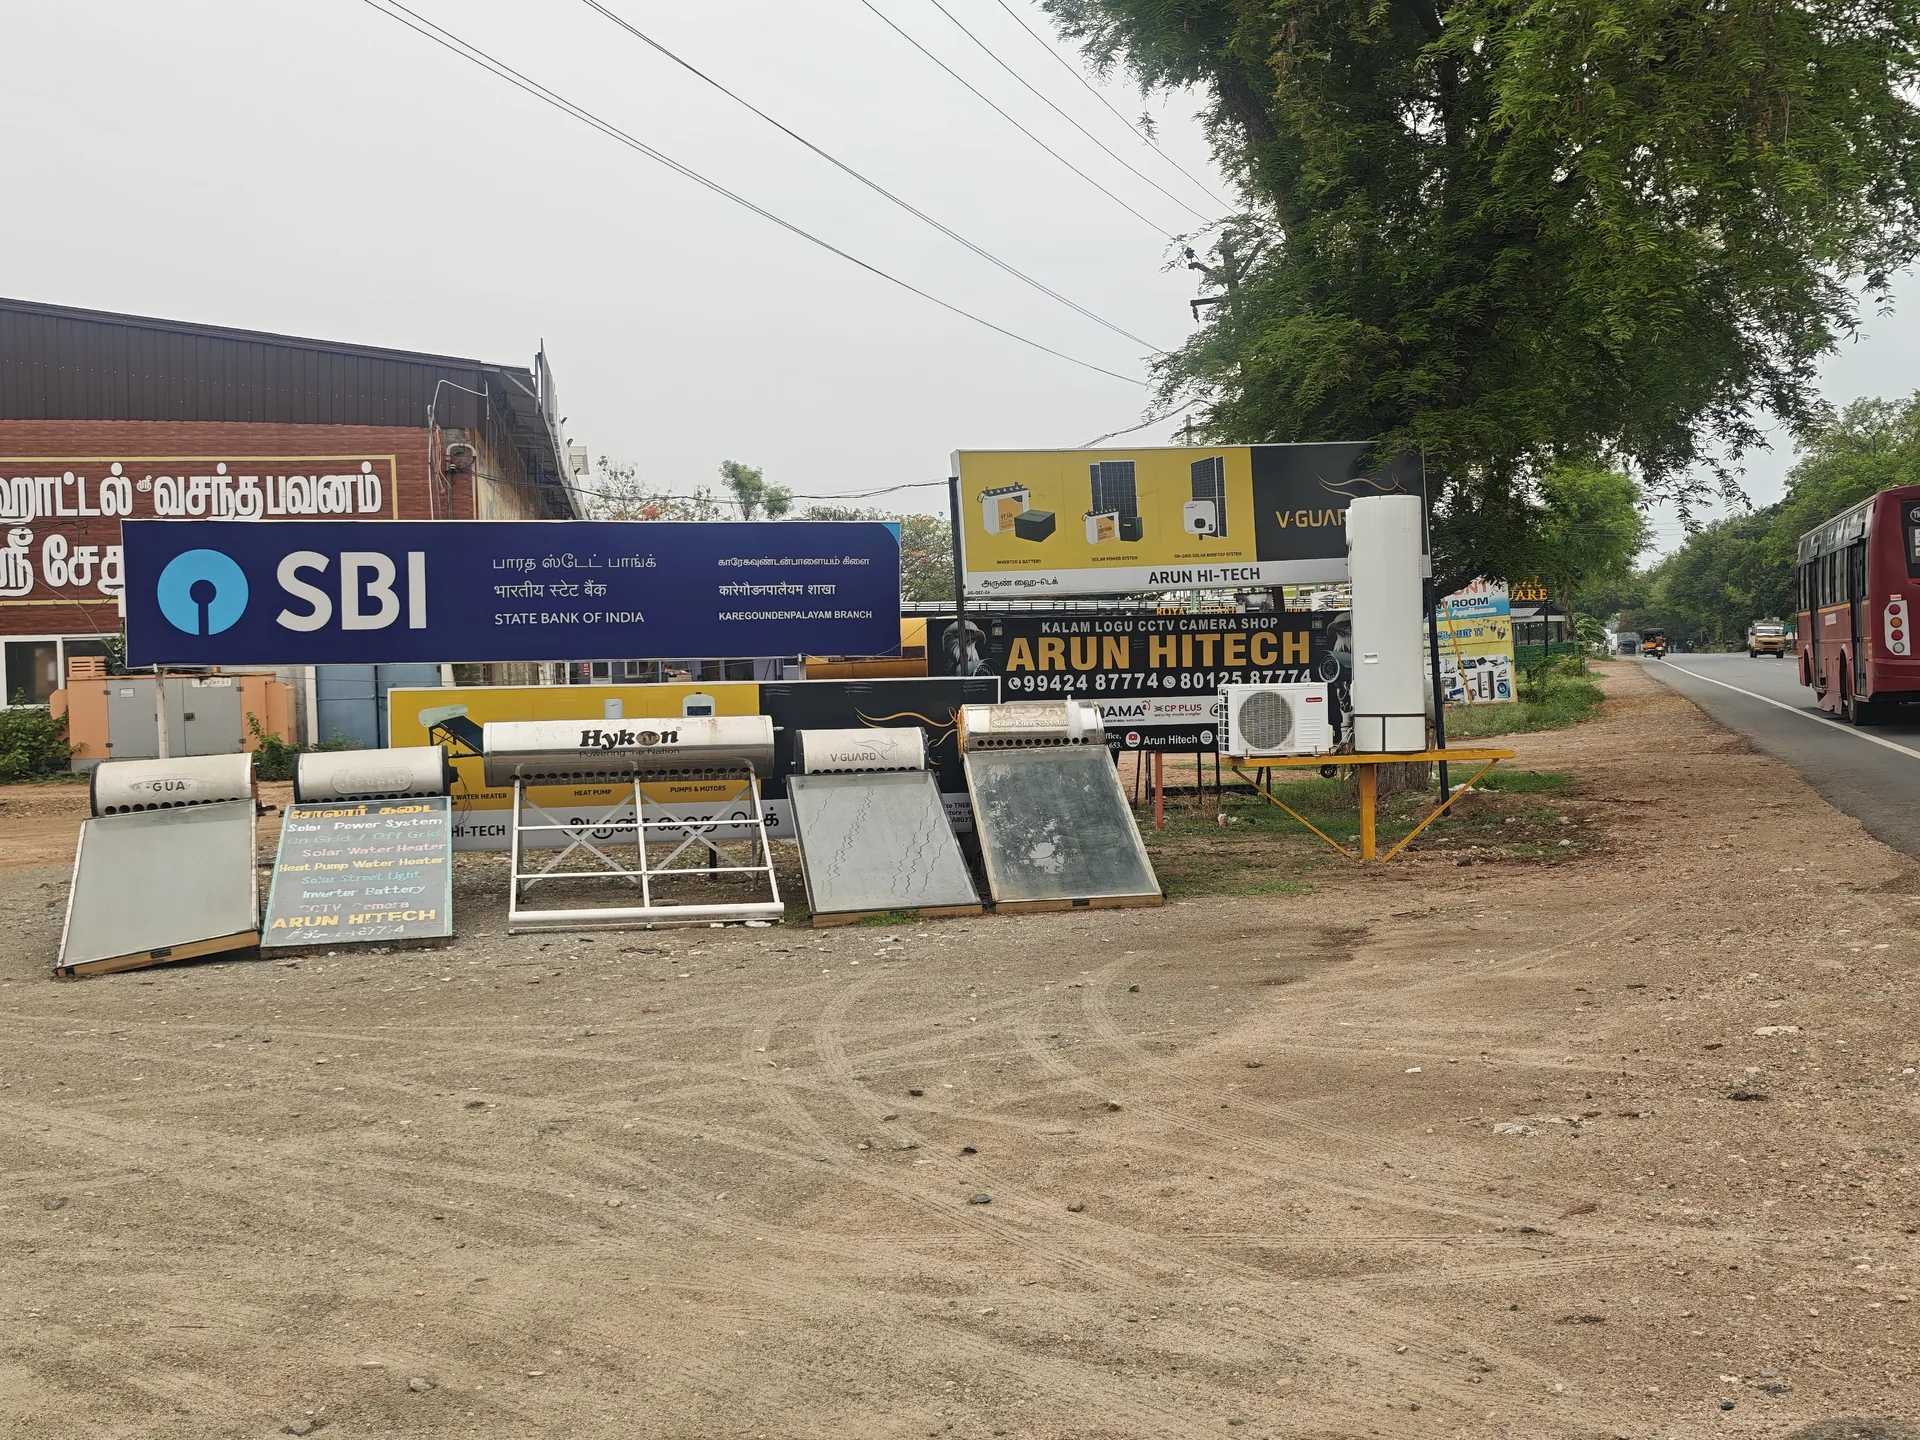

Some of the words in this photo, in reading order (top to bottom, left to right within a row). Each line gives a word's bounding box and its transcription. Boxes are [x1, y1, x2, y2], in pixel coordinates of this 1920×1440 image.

[1275, 508, 1346, 528] V-GUAR
[493, 558, 536, 573] பாரத
[542, 553, 602, 569] ஸ்டேட்
[608, 553, 657, 568] பாங்க்
[842, 555, 870, 566] கிளை
[1148, 570, 1192, 584] ARUN
[1198, 567, 1260, 582] HI-TECH
[494, 580, 545, 598] भारतीय
[549, 580, 579, 597] स्टेट
[584, 579, 607, 597] बैंक
[807, 584, 836, 595] शाखा
[981, 578, 1012, 589] அருண்
[276, 551, 427, 632] SBI
[1452, 597, 1488, 608] ROOM
[494, 612, 537, 625] STATE
[541, 612, 579, 624] BANK
[583, 611, 602, 623] OF
[606, 611, 645, 623] INDIA
[718, 610, 832, 621] KAREGOUNDENPALAYAM
[834, 610, 872, 619] BRANCH
[1042, 622, 1091, 634] KALAM
[1095, 621, 1133, 633] LOGU
[1138, 620, 1175, 632] CCTV
[1179, 618, 1236, 631] CAMERA
[1241, 617, 1278, 629] SHOP
[1006, 635, 1129, 672] ARUN
[1149, 631, 1310, 669] HITECH
[1023, 674, 1088, 692] 99424
[1095, 672, 1158, 690] 87774
[1180, 672, 1242, 689] 80125
[1250, 669, 1312, 684] 87774
[1164, 704, 1177, 712] CP
[1179, 703, 1202, 712] PLUS
[1105, 732, 1122, 740] ffice,
[1143, 735, 1166, 745] Arun
[1168, 734, 1198, 745] Hitech
[579, 750, 625, 758] Powering
[480, 792, 507, 800] HEATER
[290, 805, 368, 820] சோலார்
[379, 804, 439, 816] கடை
[385, 818, 442, 828] System
[452, 825, 505, 837] HI-TECH
[302, 849, 342, 858] Solar
[347, 846, 394, 855] Water
[397, 843, 447, 852] Heater
[279, 863, 311, 872] Heat
[314, 863, 349, 871] Pump
[352, 859, 396, 869] Water
[399, 856, 445, 866] Heater
[388, 871, 421, 881] Light
[271, 915, 339, 929] ARUN
